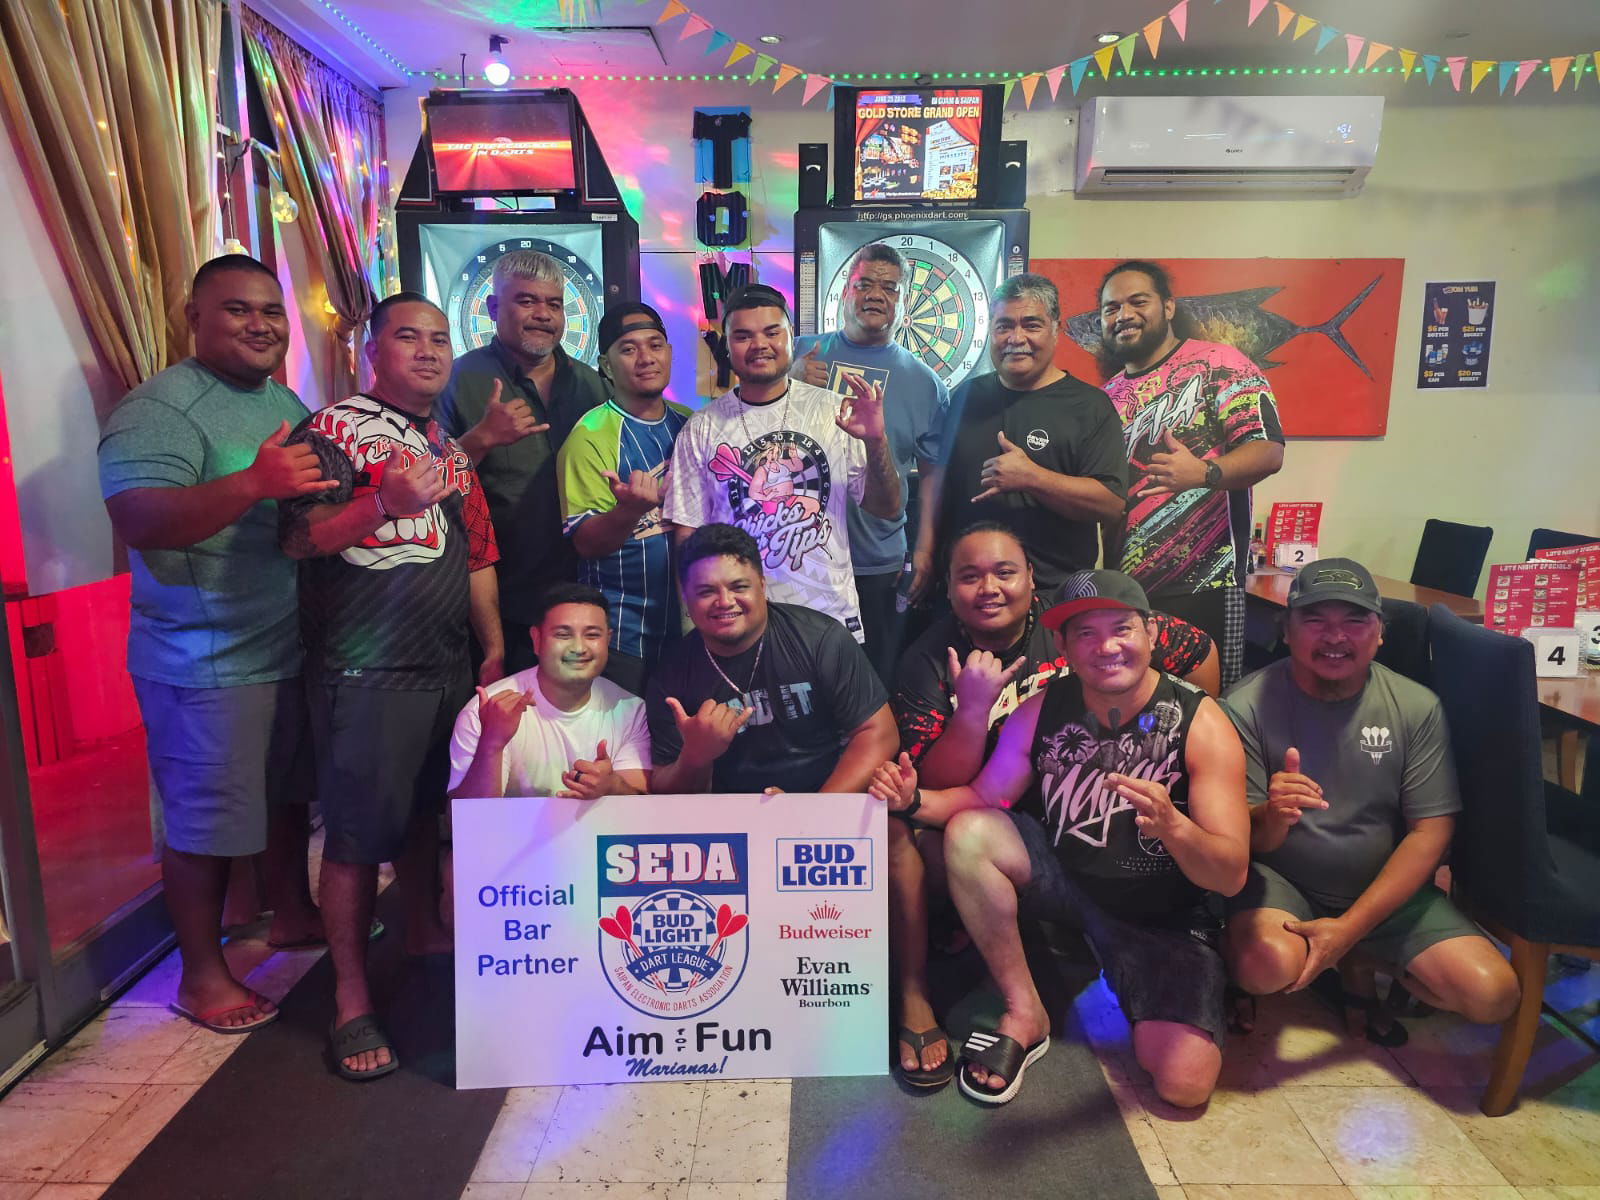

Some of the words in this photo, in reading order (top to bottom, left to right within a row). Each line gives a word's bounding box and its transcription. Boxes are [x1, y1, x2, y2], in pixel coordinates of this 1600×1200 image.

[858, 108, 885, 119] GOLD
[887, 107, 921, 118] STORE
[923, 107, 954, 118] GRAND
[956, 107, 979, 118] OPEN
[520, 240, 532, 249] 20
[901, 237, 913, 246] 20
[929, 242, 934, 250] 1
[499, 244, 506, 252] 5
[477, 255, 487, 263] 12
[567, 255, 577, 264] 18
[948, 254, 958, 263] 18
[586, 273, 593, 281] 4
[964, 270, 971, 279] 4
[829, 292, 840, 302] 14
[974, 292, 984, 301] 13
[978, 314, 985, 325] 6
[973, 339, 983, 349] 10
[962, 360, 973, 370] 15
[946, 378, 953, 388] 2
[760, 438, 767, 447] 5
[802, 437, 813, 448] 18
[743, 445, 756, 456] 12
[814, 448, 822, 456] 4
[766, 511, 831, 571] Tips
[1294, 550, 1304, 562] 2
[1517, 563, 1538, 571] NIGHT
[1547, 646, 1566, 666] 4
[793, 844, 855, 865] BUD
[605, 842, 739, 885] SEDA
[782, 865, 867, 887] LIGHT
[478, 883, 575, 907] Official
[653, 914, 695, 928] BUD
[504, 919, 552, 941] Bar
[644, 928, 703, 943] LIGHT
[779, 924, 872, 940] Budweiser
[477, 953, 579, 977] Partner
[640, 953, 668, 972] DART
[671, 953, 710, 971] LEAGUE
[796, 956, 852, 975] Evan
[614, 966, 633, 991] SAIPAN
[630, 986, 671, 1012] ELECTRONIC
[673, 998, 698, 1012] DARTS
[699, 965, 734, 1003] ASSOCIATION
[780, 977, 872, 997] Williams
[799, 998, 850, 1008] Bourbon
[582, 1025, 664, 1058] Aim
[696, 1022, 772, 1053] Fun
[625, 1055, 729, 1077] Marianas!
